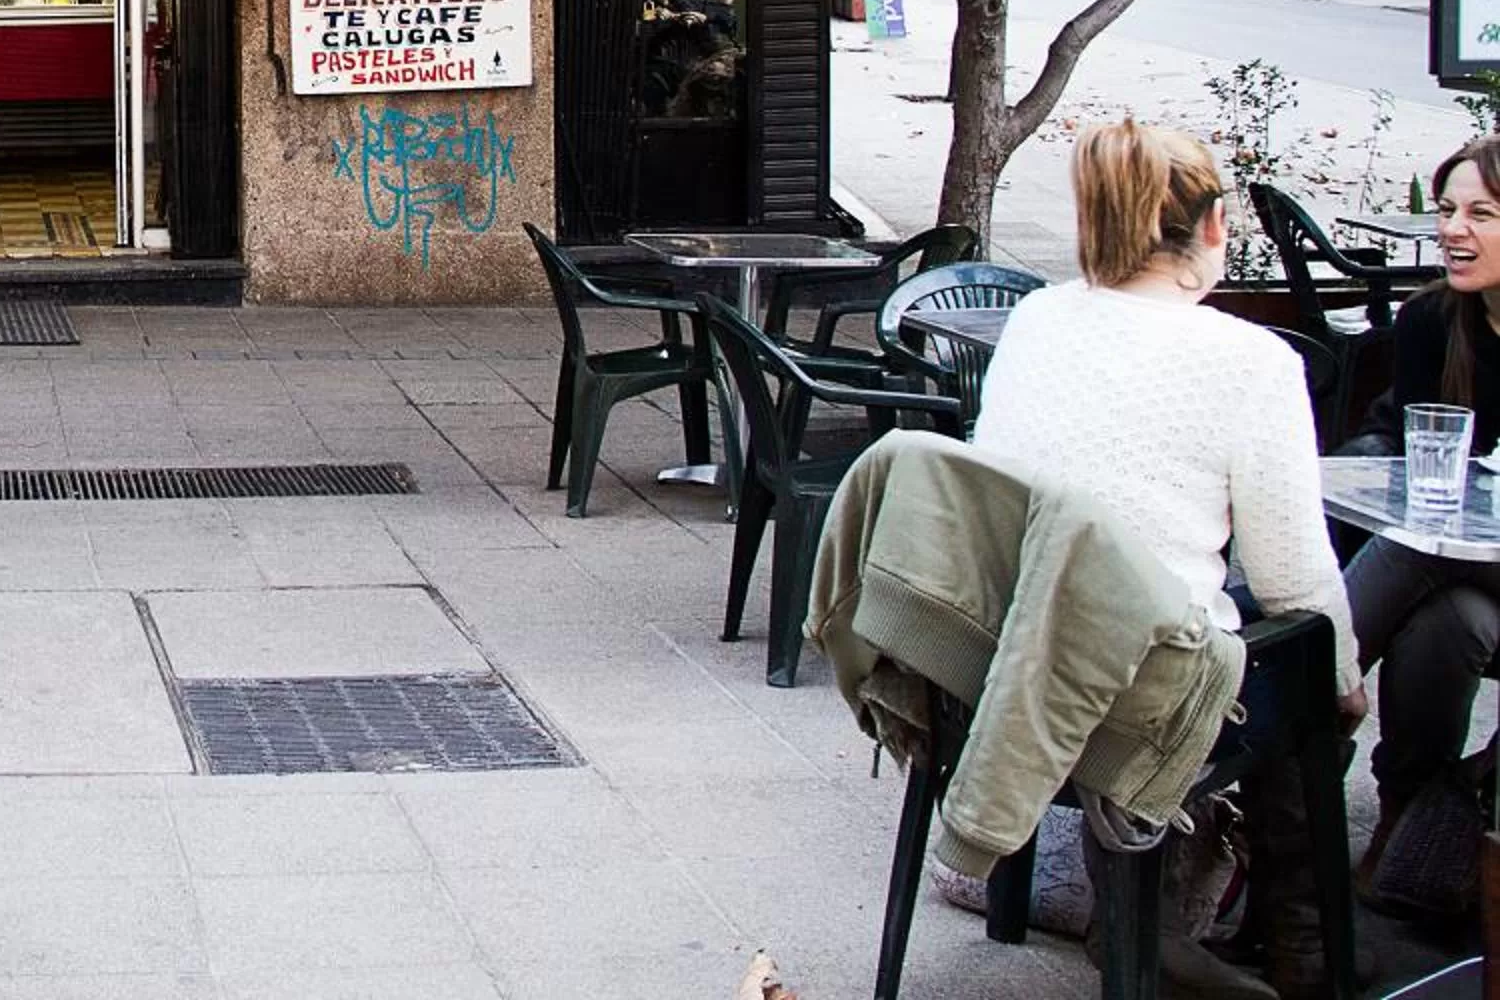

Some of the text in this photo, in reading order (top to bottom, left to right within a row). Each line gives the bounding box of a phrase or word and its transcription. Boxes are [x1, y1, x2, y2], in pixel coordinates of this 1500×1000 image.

[323, 5, 482, 28] TE Y CAFE
[321, 26, 476, 48] CALUGAS
[311, 47, 436, 75] PASTELES
[351, 58, 475, 85] SANDWICH
